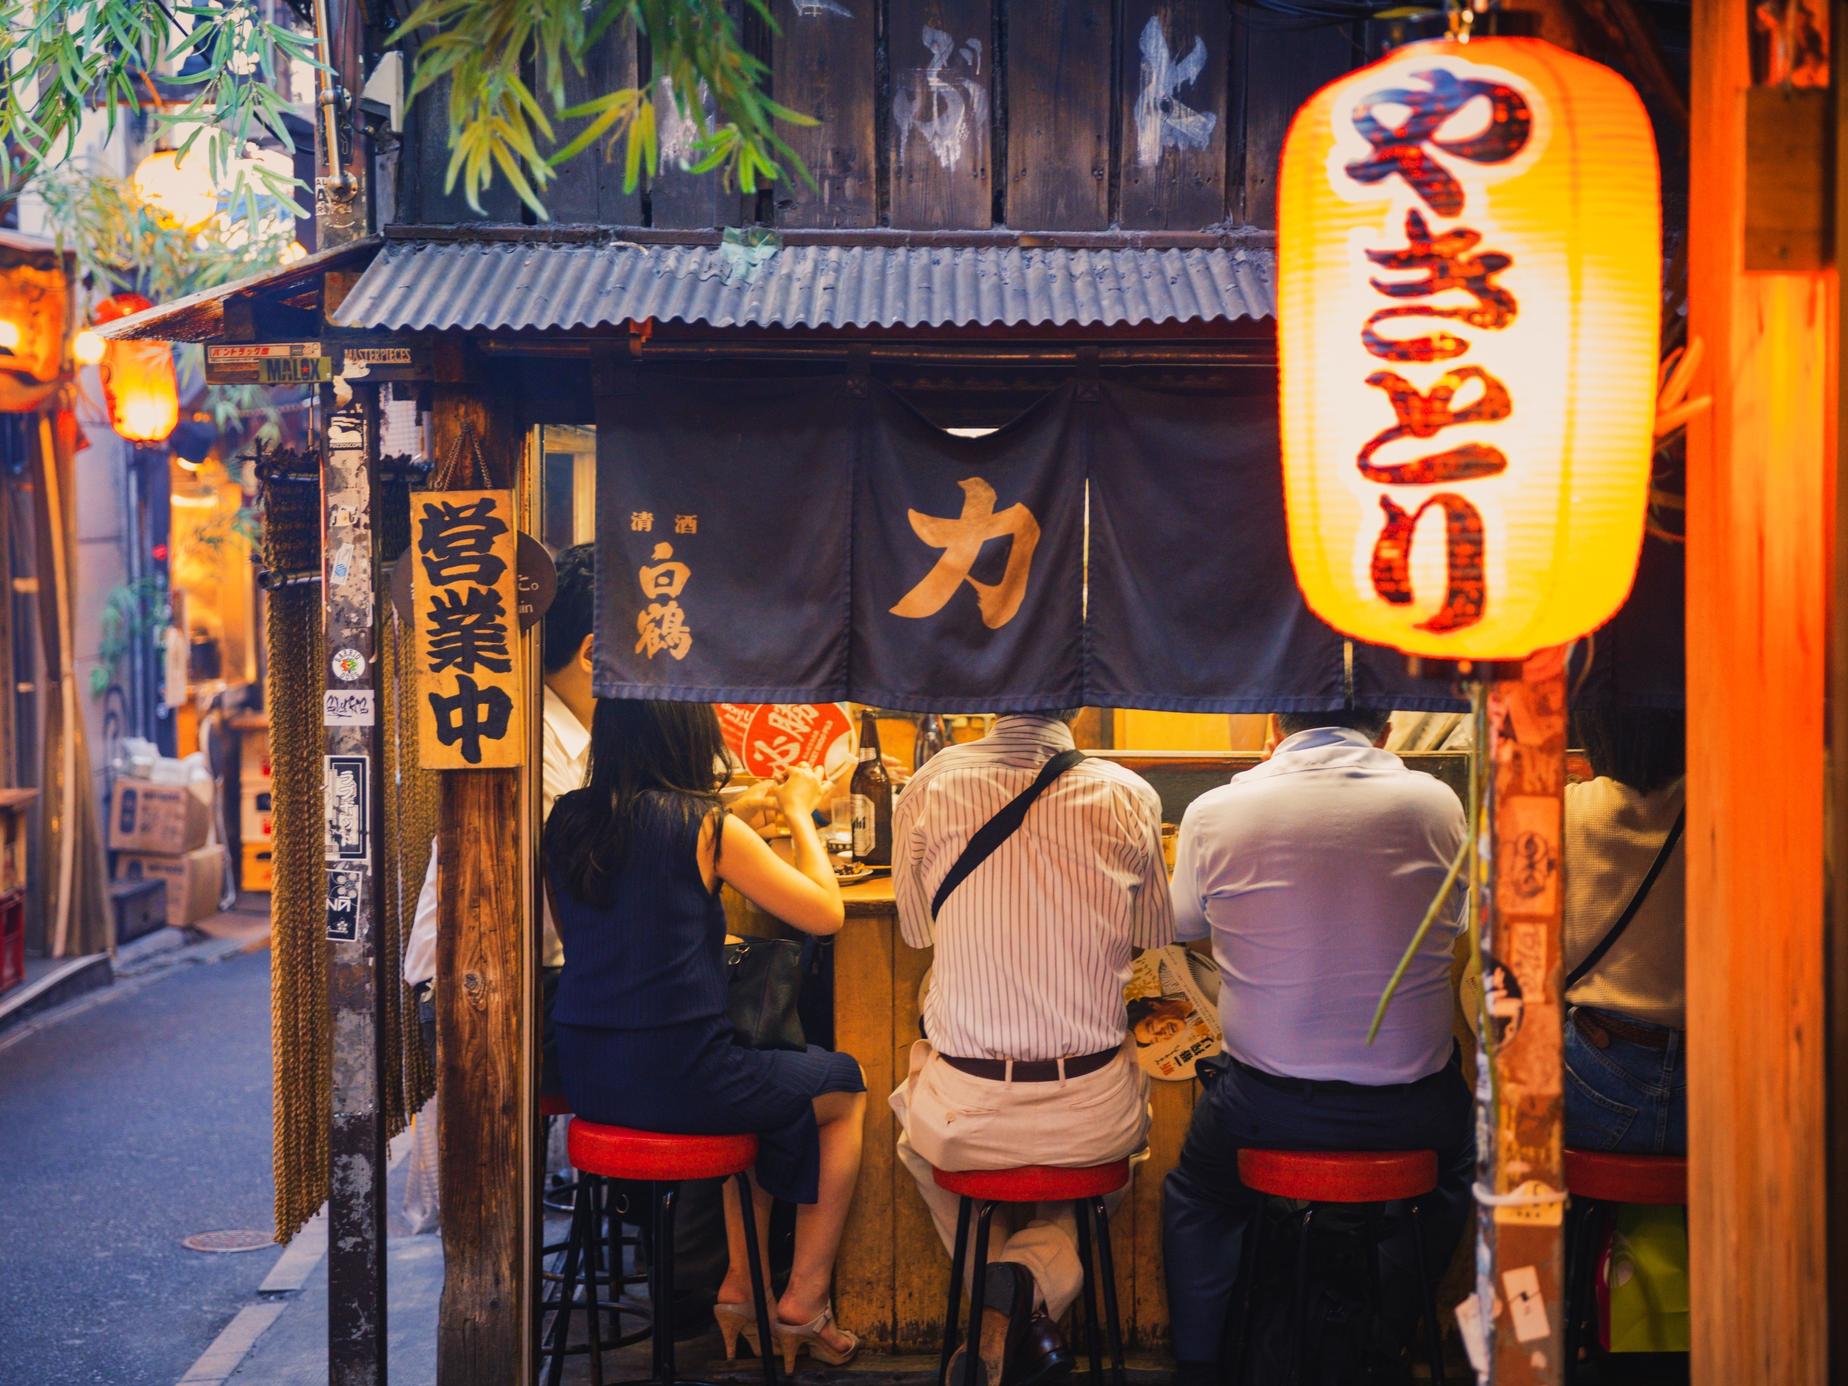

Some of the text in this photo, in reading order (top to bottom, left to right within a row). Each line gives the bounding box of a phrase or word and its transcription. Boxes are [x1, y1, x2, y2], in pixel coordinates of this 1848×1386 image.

[1342, 66, 1533, 636] やきとり
[418, 497, 514, 765] 営業中
[635, 541, 694, 661] 白鶴
[888, 476, 1041, 630] 力
